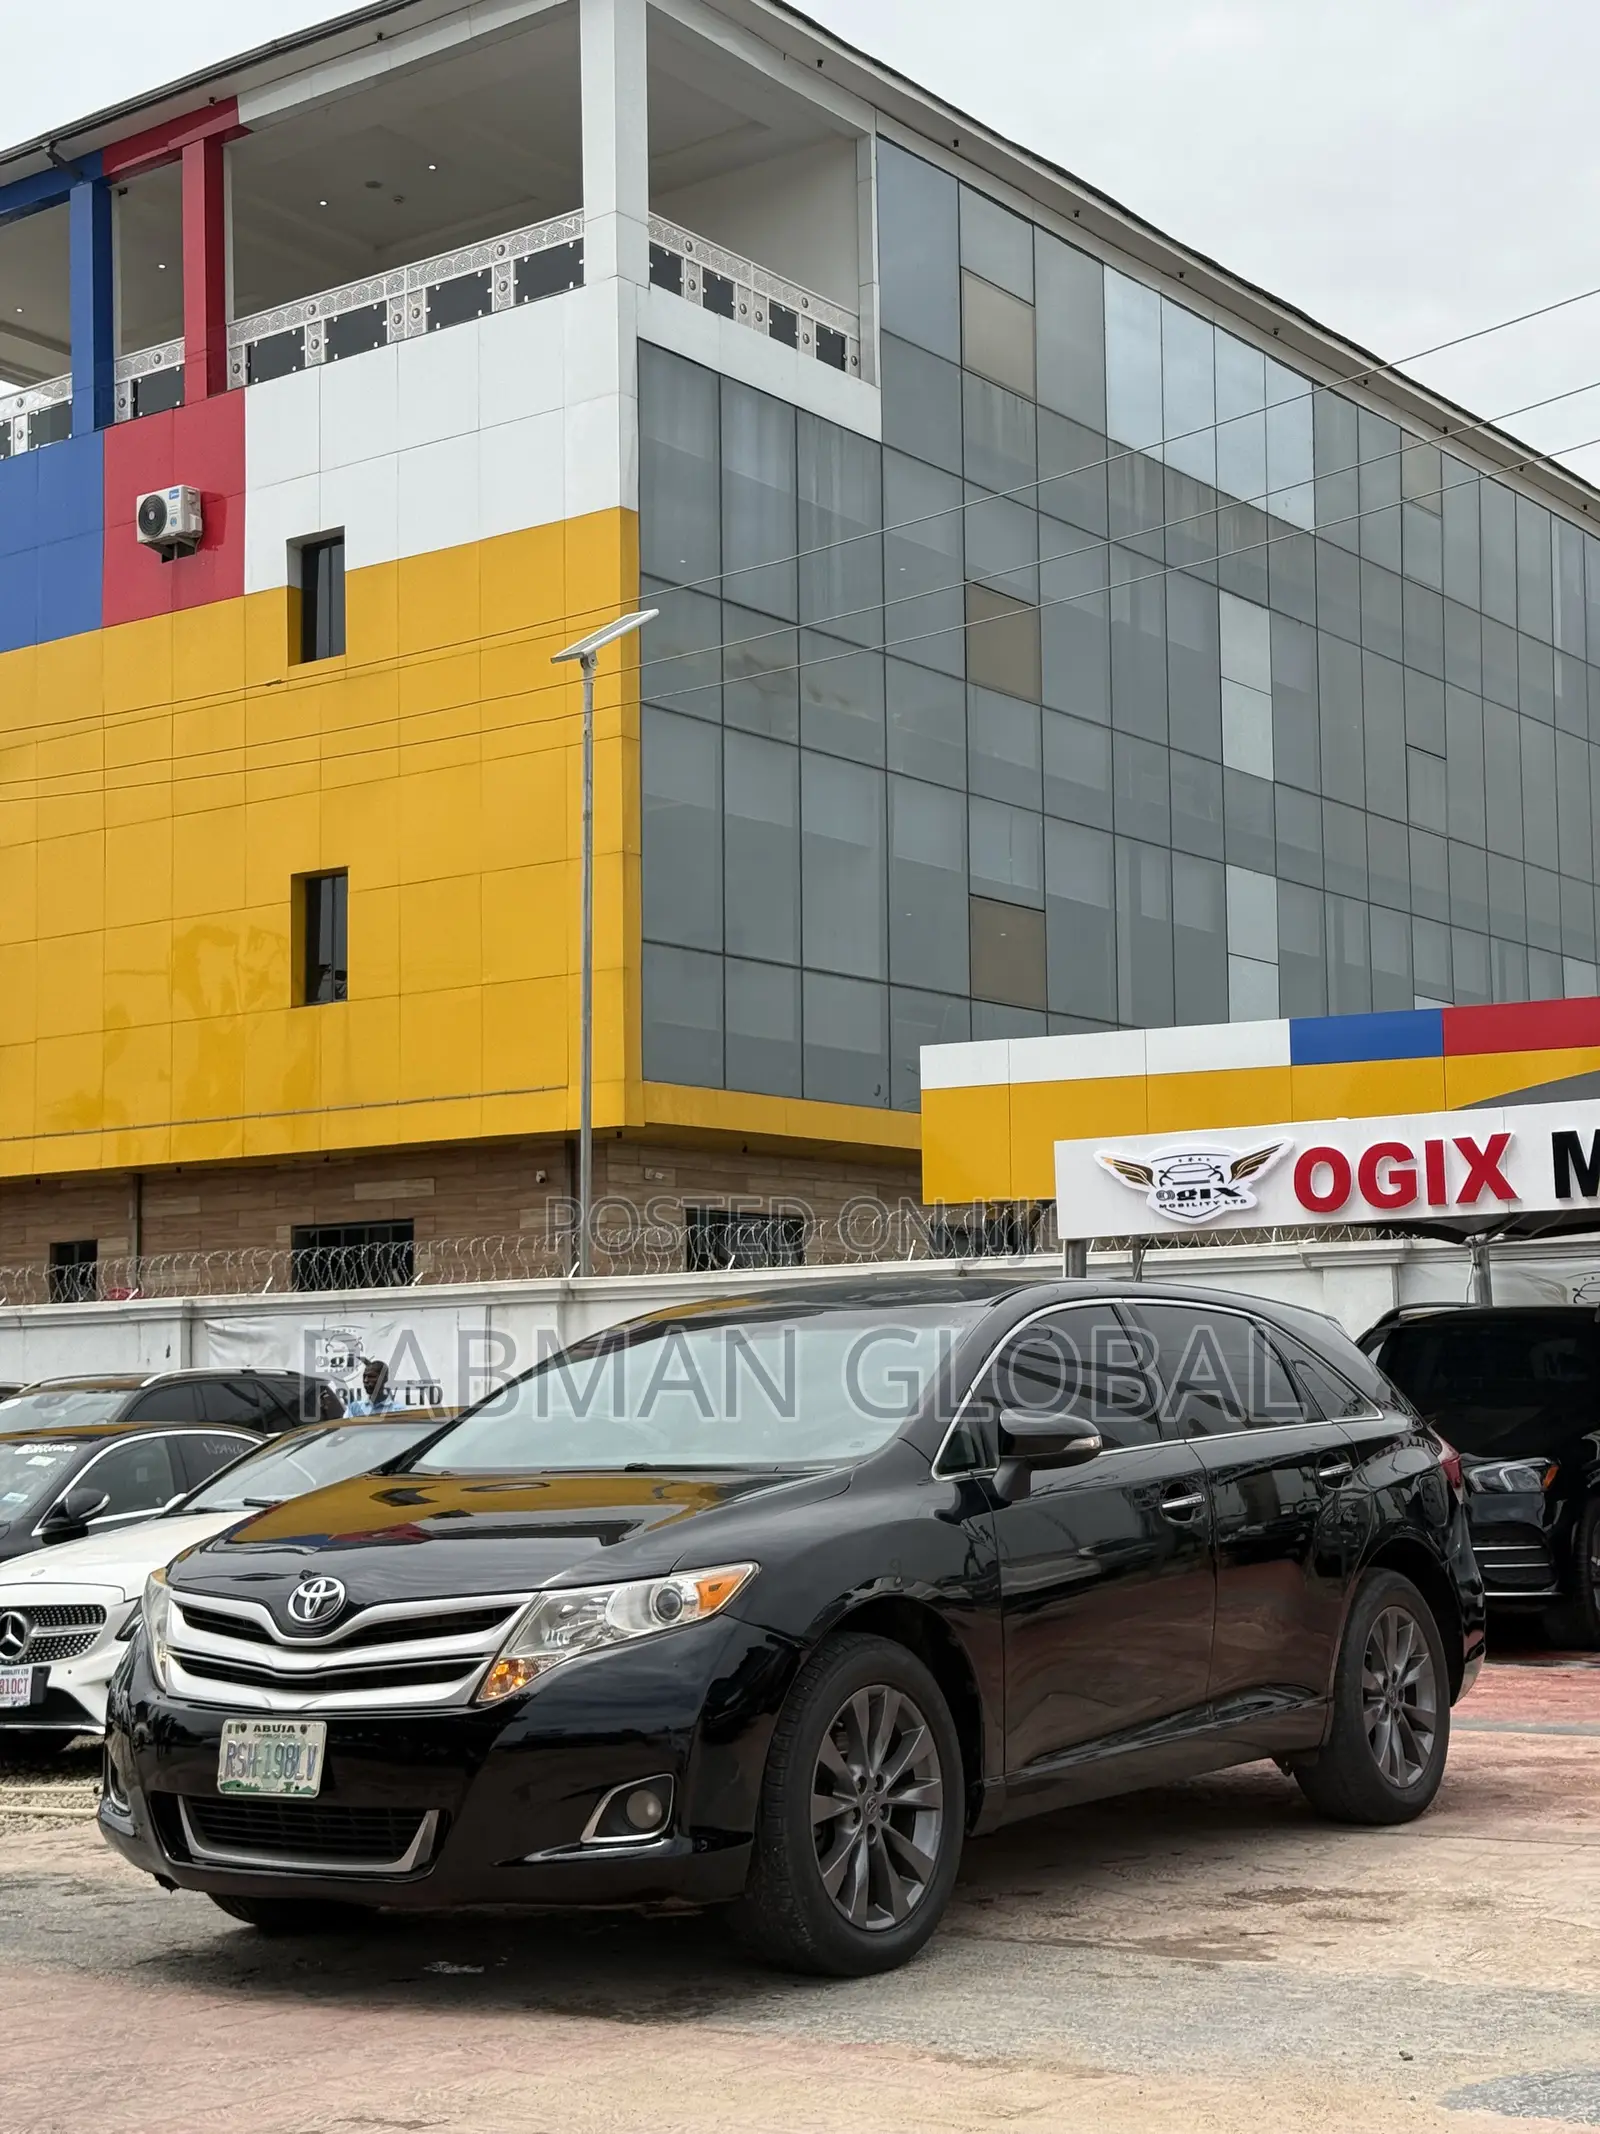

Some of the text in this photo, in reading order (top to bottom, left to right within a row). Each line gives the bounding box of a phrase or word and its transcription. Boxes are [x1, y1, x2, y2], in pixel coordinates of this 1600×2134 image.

[1293, 1132, 1520, 1213] OGIX
[1159, 1198, 1248, 1209] MOBILITY LTD
[405, 1385, 444, 1406] LTD
[253, 1724, 296, 1733] ABUJA
